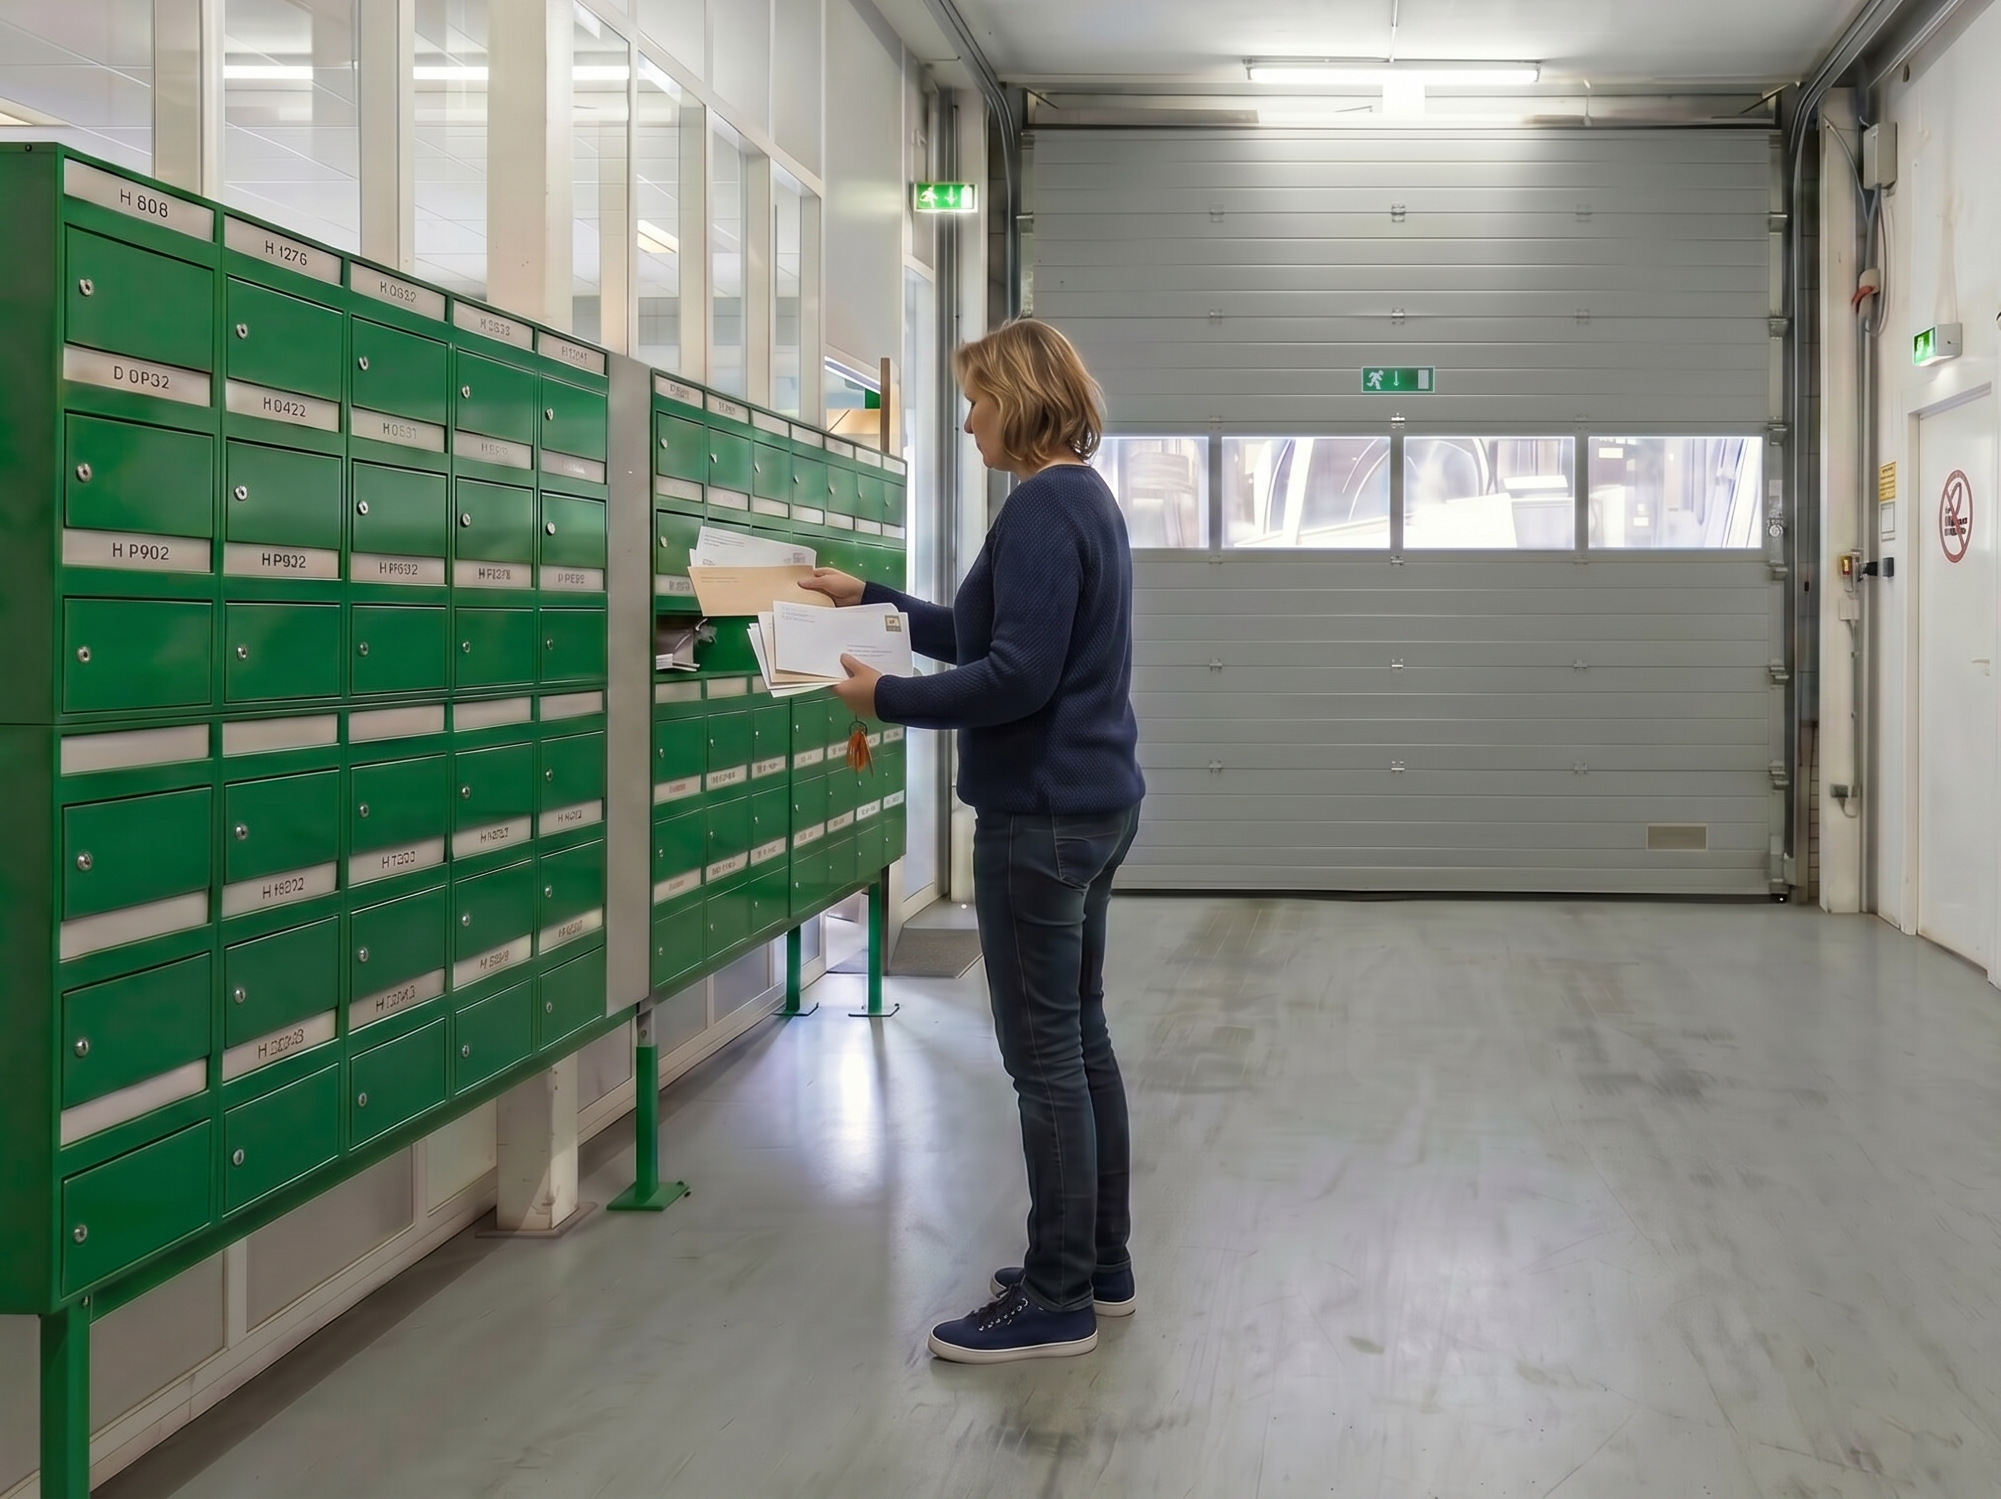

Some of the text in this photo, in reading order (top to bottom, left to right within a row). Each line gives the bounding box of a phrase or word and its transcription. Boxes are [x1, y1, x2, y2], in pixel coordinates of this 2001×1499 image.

[120, 188, 168, 218] H 808
[265, 240, 308, 266] H 1276
[379, 281, 387, 294] H
[113, 366, 124, 380] D
[112, 543, 169, 560] H P902
